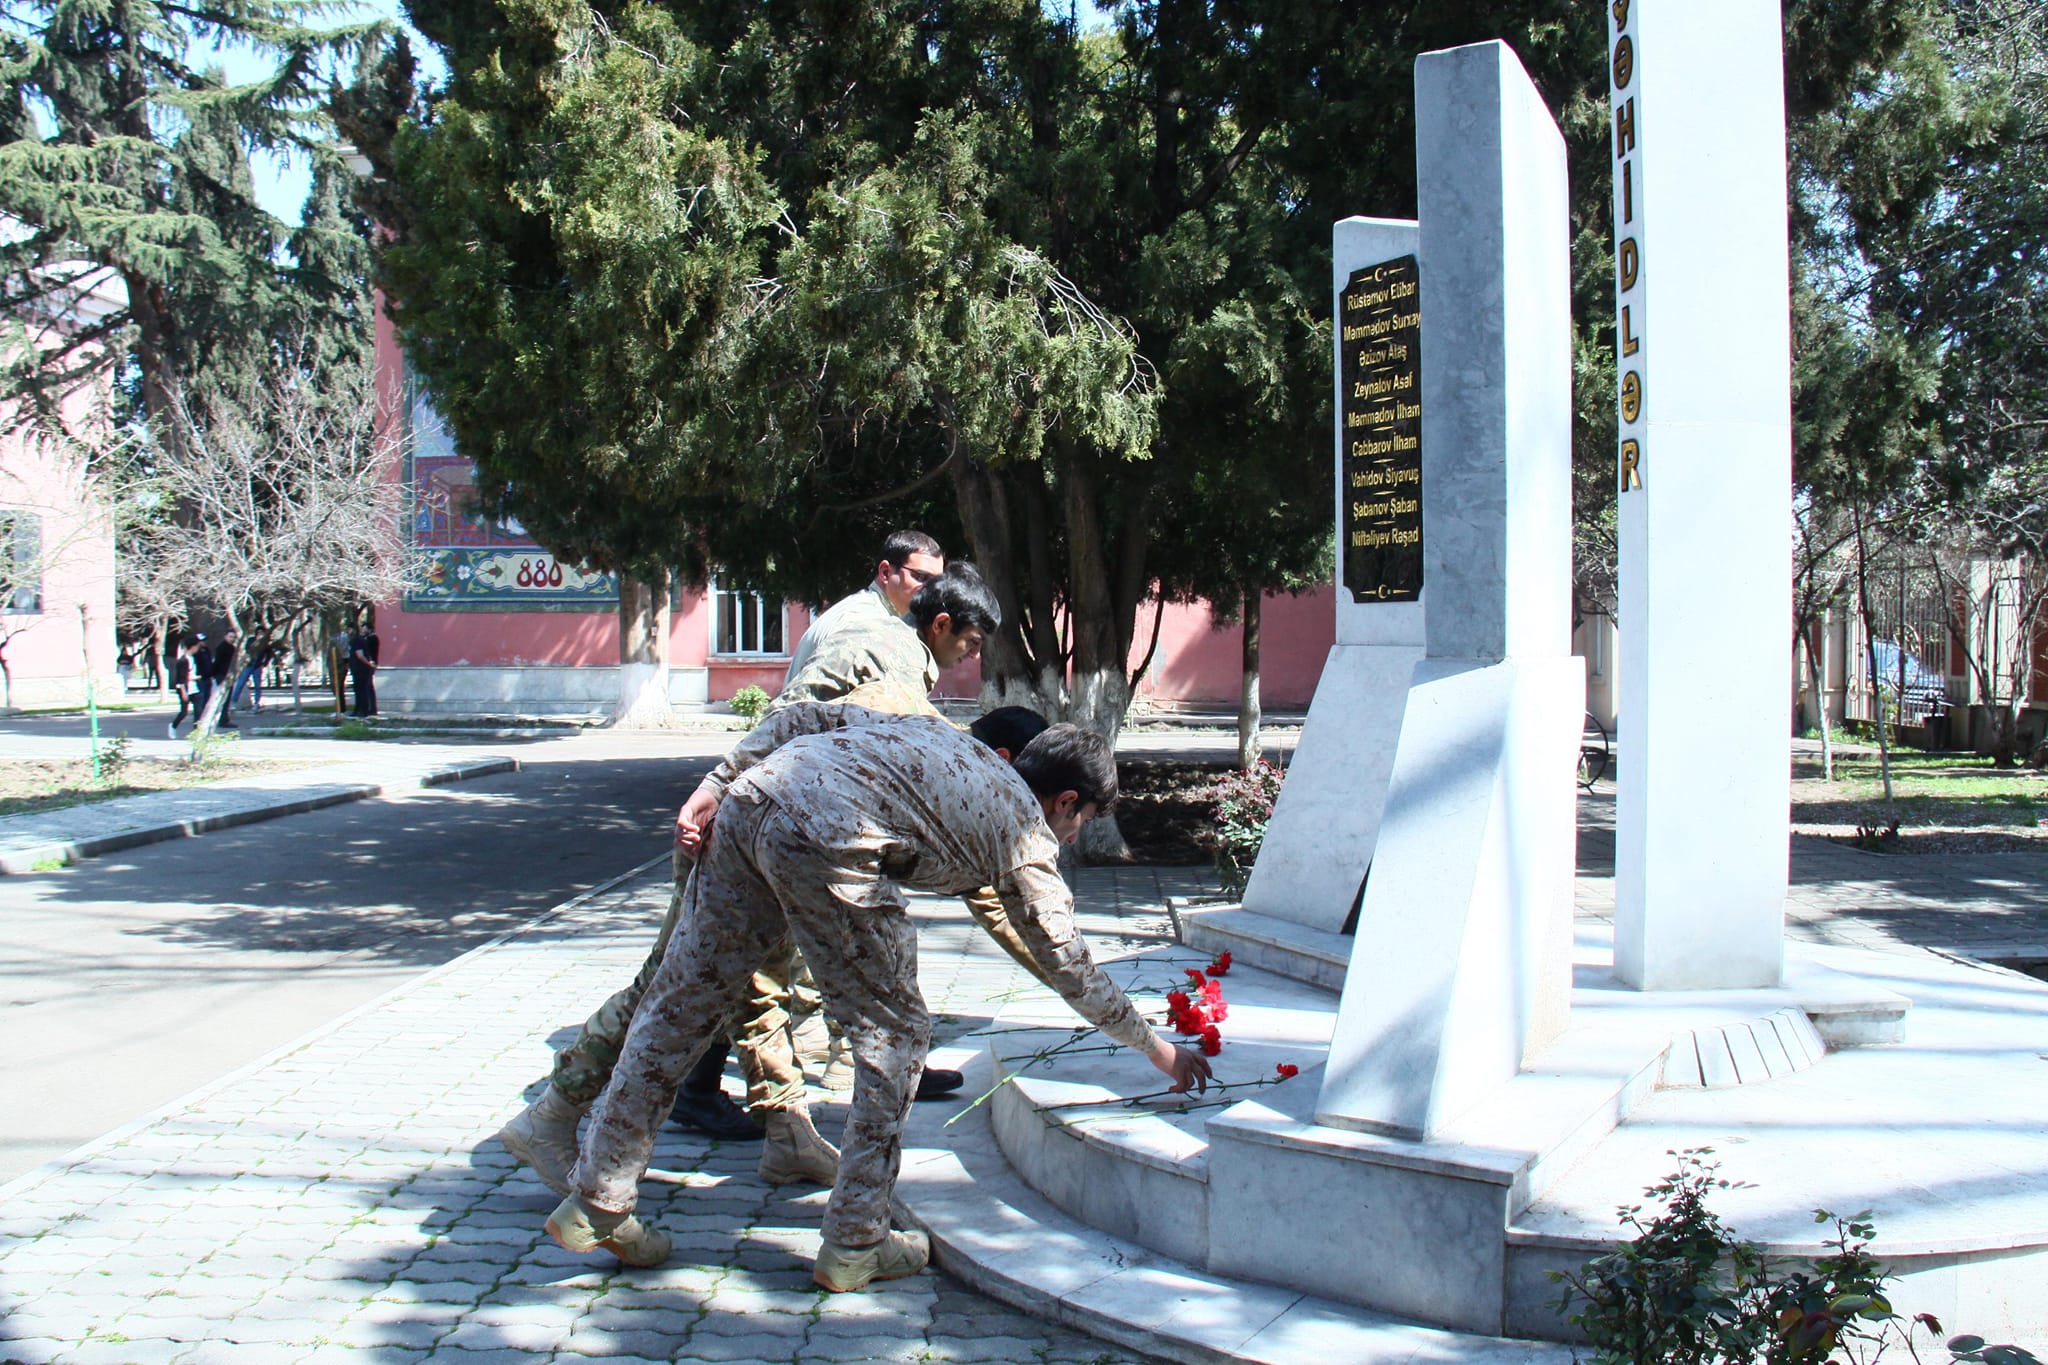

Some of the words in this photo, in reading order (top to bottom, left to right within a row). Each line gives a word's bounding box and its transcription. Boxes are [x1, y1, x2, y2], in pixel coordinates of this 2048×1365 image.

[1343, 319, 1391, 341] Məmmədov
[1359, 349, 1387, 367] Əzizov
[1354, 378, 1392, 400] Zeynalov
[1348, 407, 1395, 428] Məmmədov
[1352, 439, 1392, 457] Cabbarov
[1353, 501, 1389, 521] Şabanov
[1390, 497, 1417, 518] Şaban
